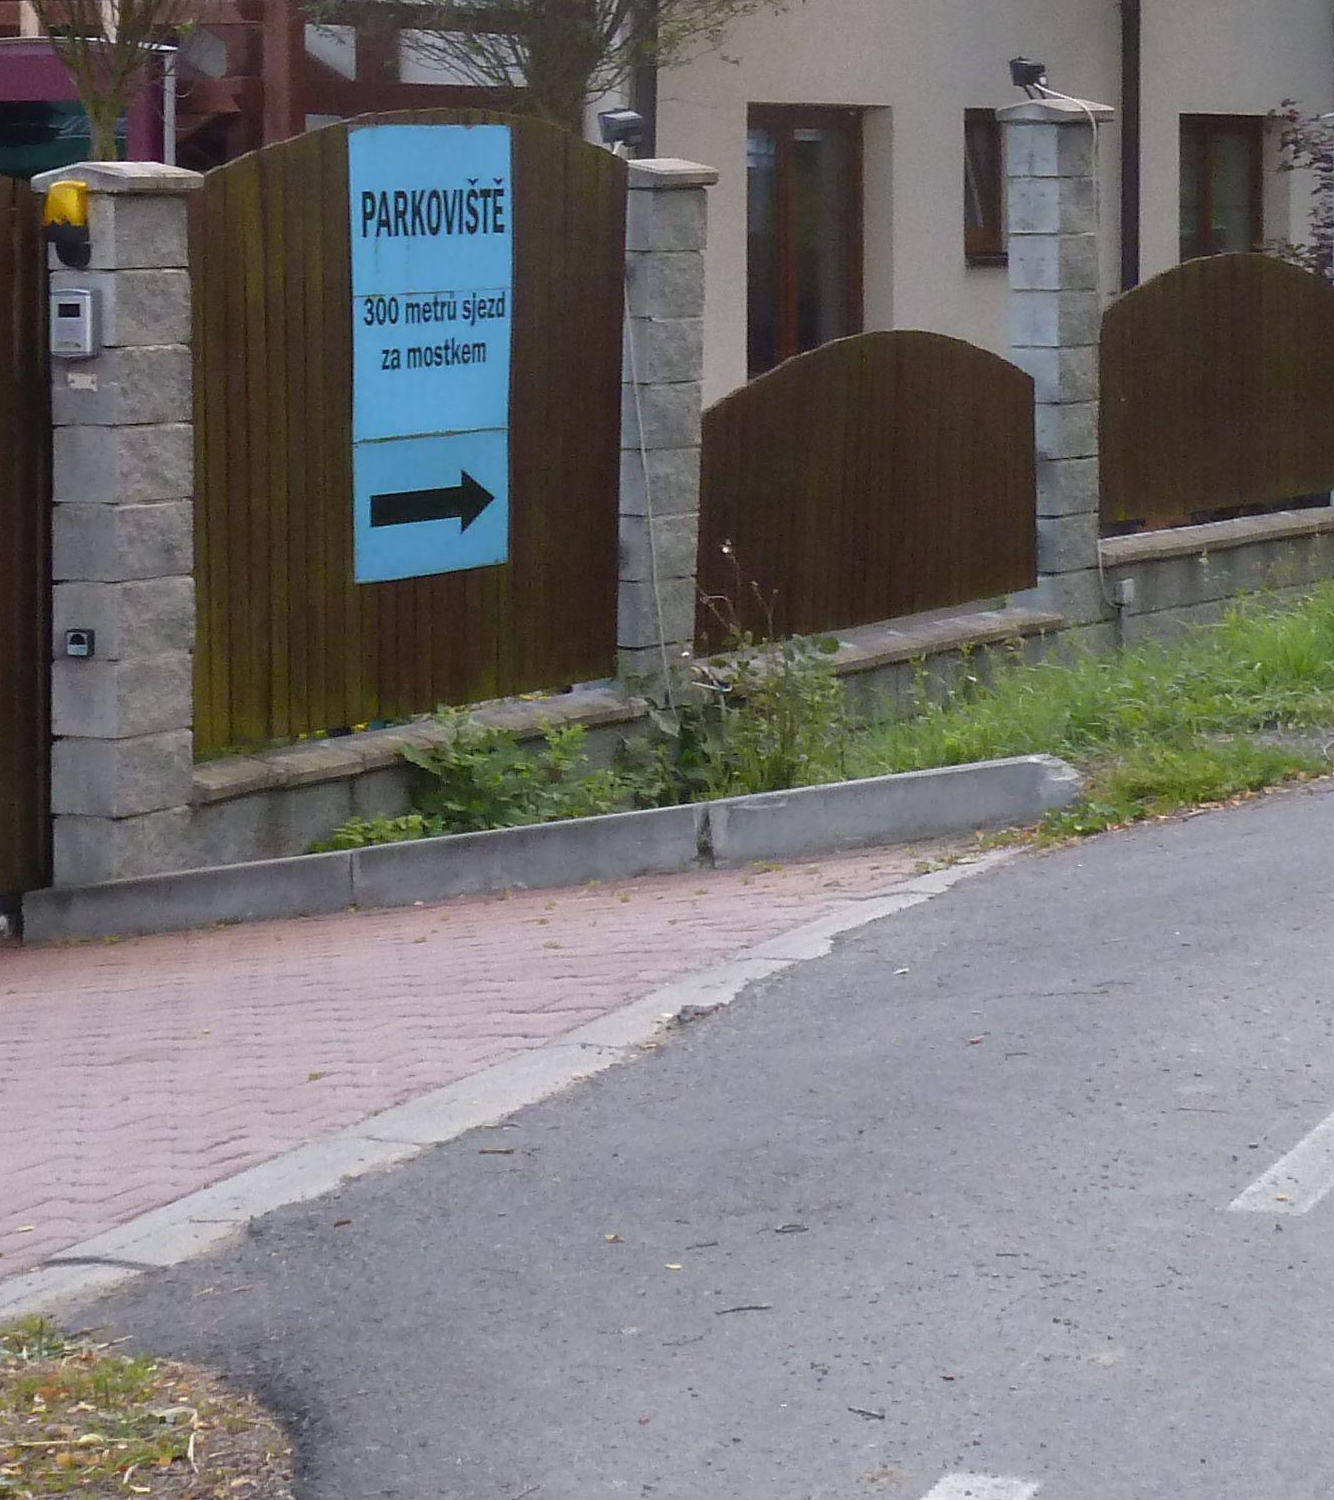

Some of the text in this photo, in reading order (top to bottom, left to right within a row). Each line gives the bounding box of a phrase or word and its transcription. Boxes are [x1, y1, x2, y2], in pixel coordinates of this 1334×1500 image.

[360, 177, 506, 238] PARKOVIŠTĚ
[363, 290, 506, 328] 300 metrů sjezd
[381, 337, 487, 371] za mostkem
